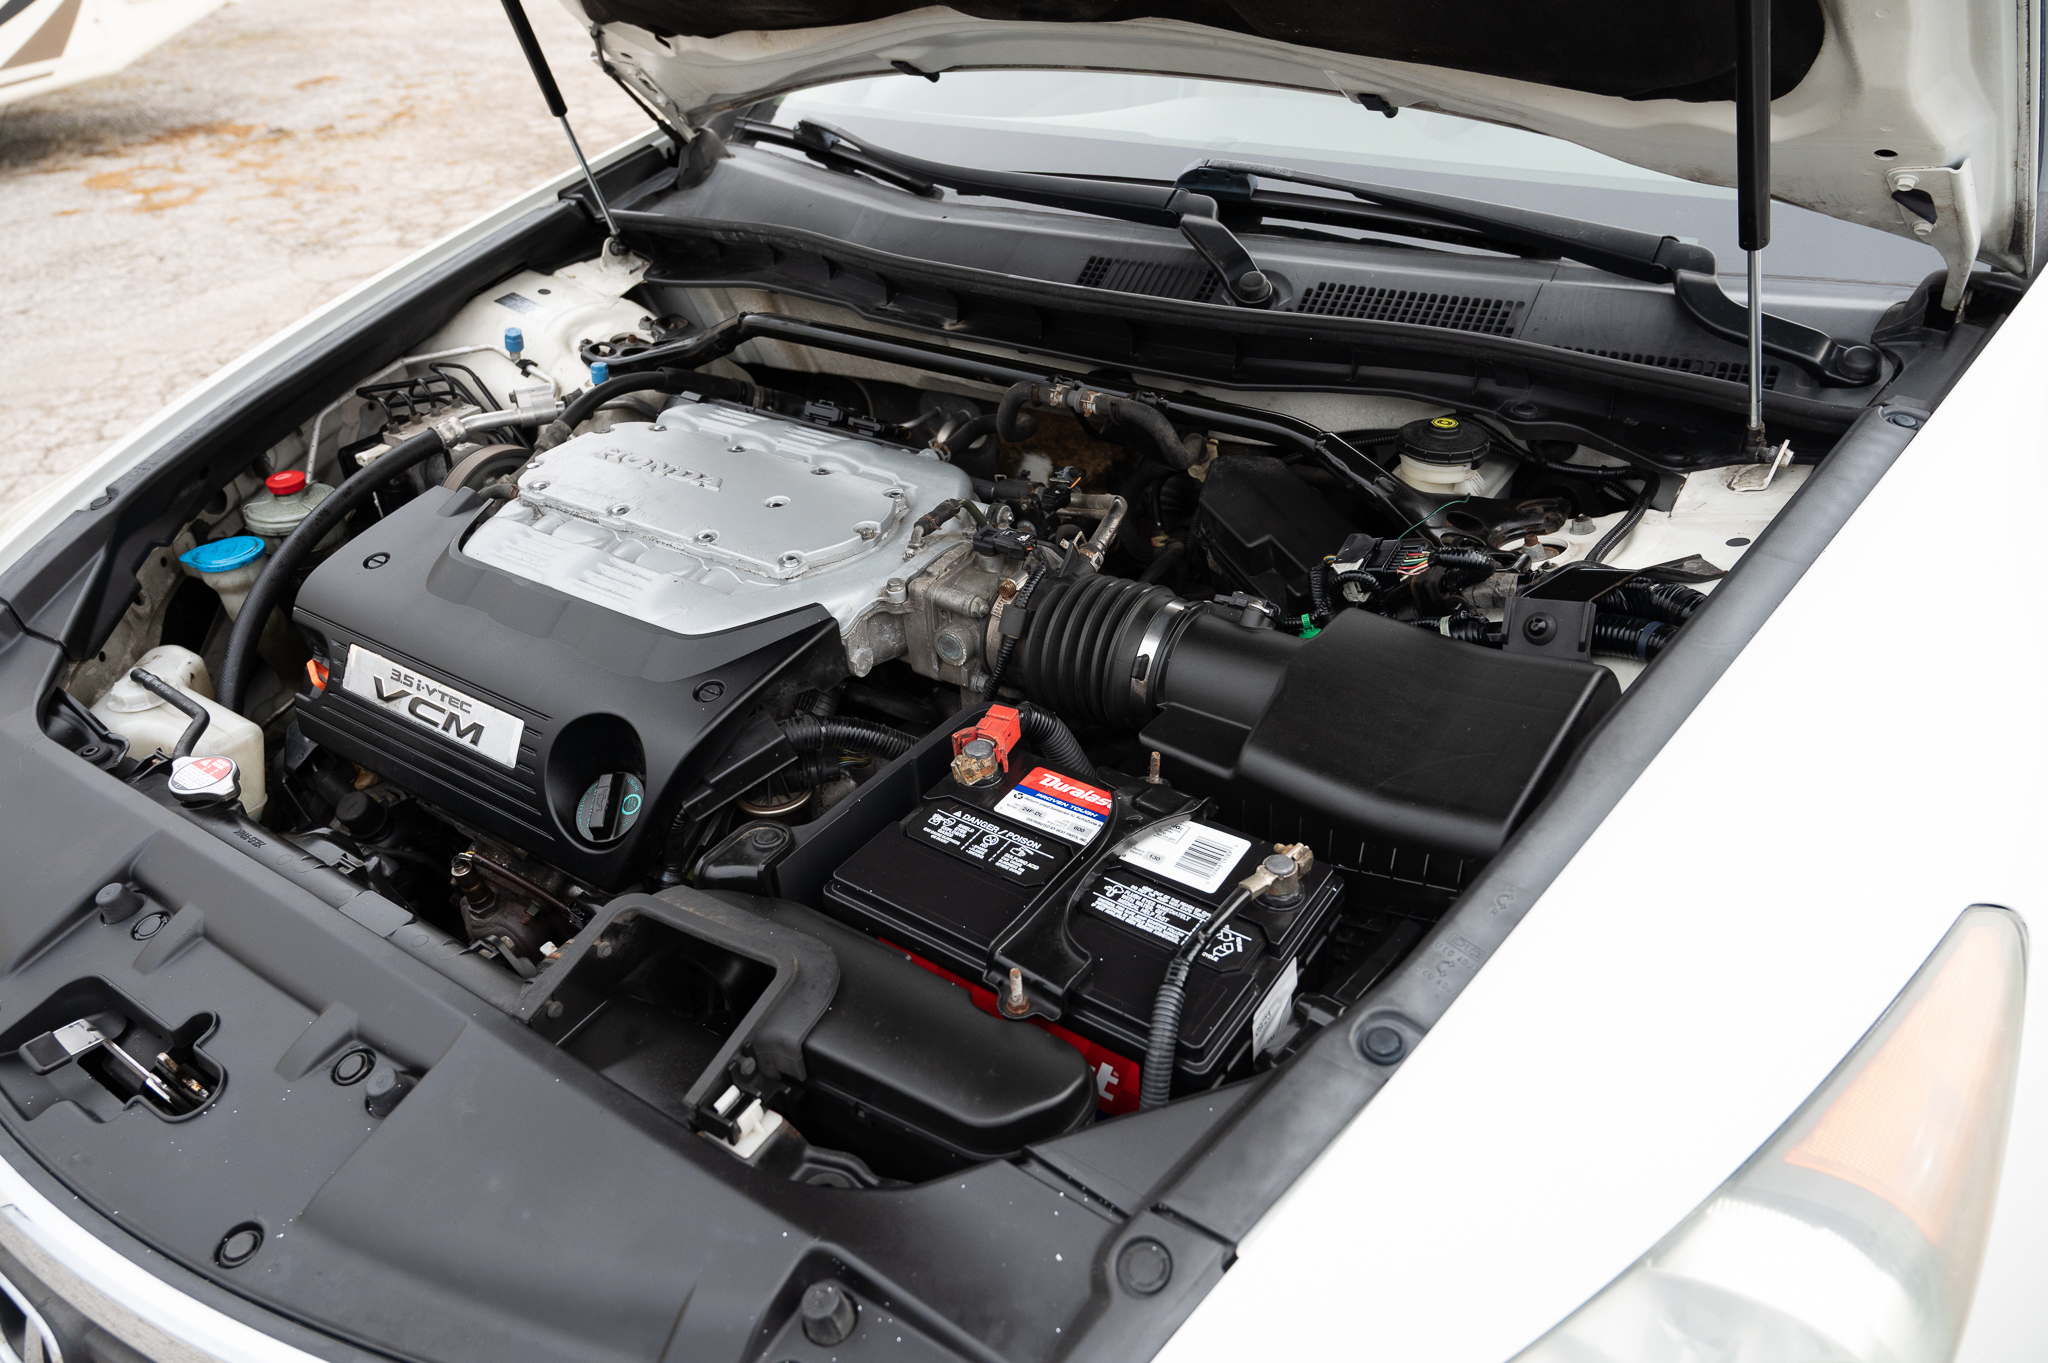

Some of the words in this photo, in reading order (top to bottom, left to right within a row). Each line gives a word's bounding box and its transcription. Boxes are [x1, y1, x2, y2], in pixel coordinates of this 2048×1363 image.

[593, 448, 723, 492] HONDA
[390, 667, 415, 688] 3.5
[373, 675, 486, 747] VCM
[1039, 773, 1112, 809] Duralas
[1021, 806, 1043, 818] 24F-DL
[1035, 792, 1069, 808] PROVEN
[1070, 804, 1099, 818] TOUGH
[962, 814, 1000, 833] DANGER
[1006, 831, 1042, 850] POISON
[1073, 825, 1086, 833] 600
[1149, 854, 1161, 862] 130
